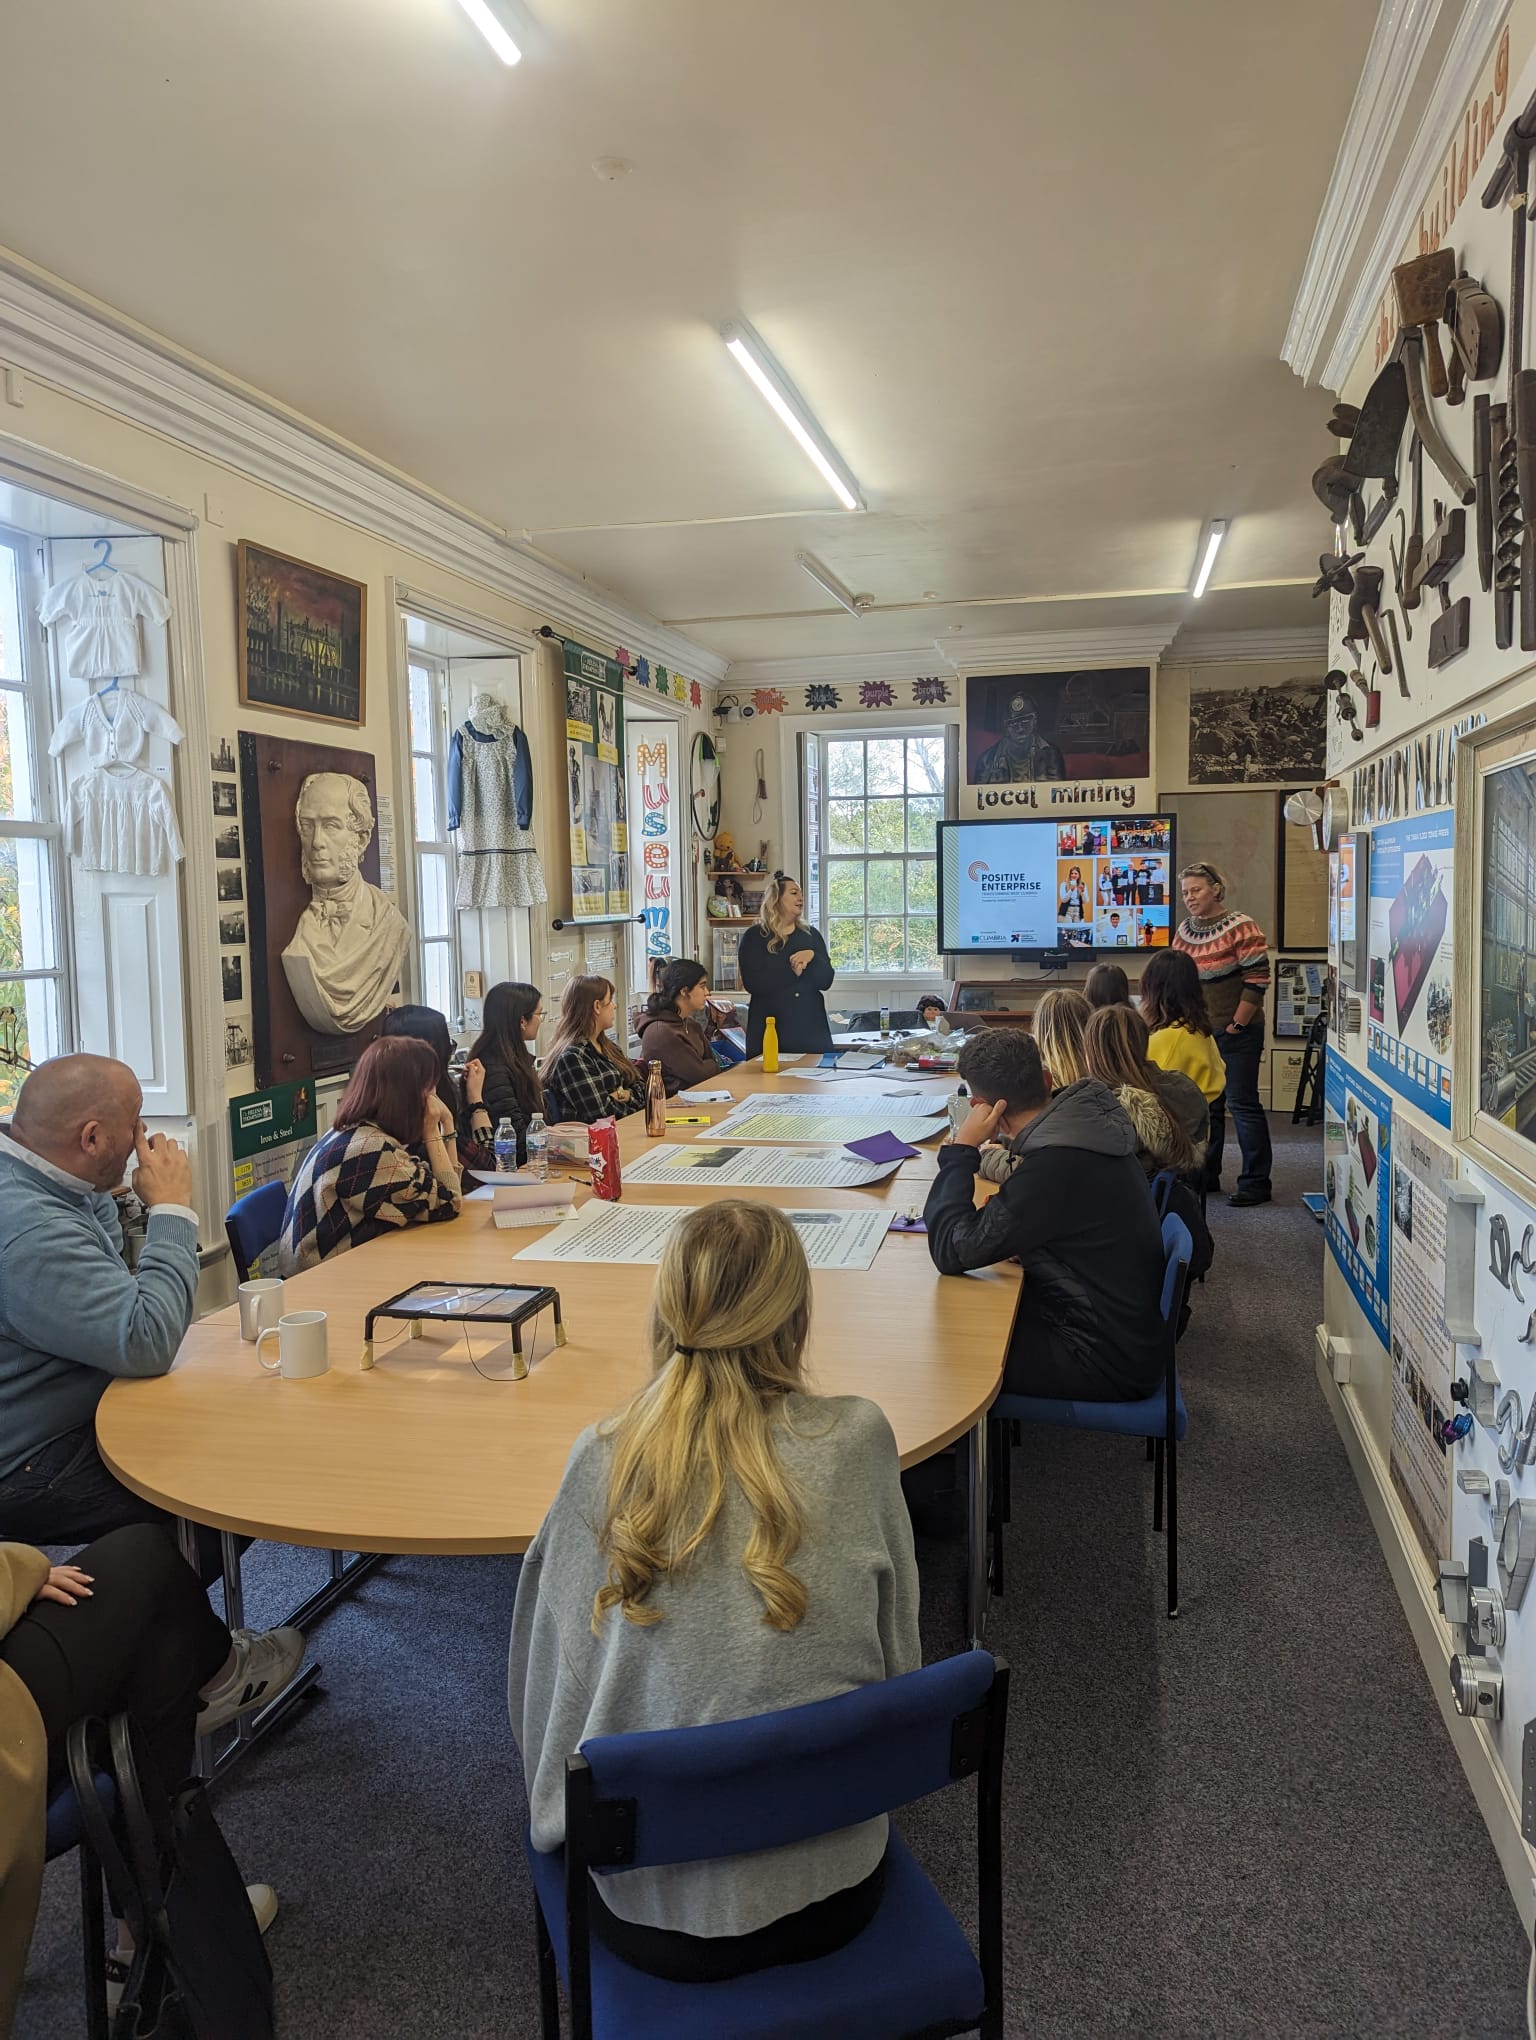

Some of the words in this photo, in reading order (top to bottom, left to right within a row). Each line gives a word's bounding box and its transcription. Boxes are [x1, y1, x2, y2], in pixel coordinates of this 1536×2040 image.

[1419, 24, 1510, 257] building
[865, 688, 889, 701] purple
[977, 785, 1039, 810] local
[1051, 780, 1136, 808] mining
[637, 743, 672, 956] Museums
[981, 873, 1026, 882] POSITIVE
[981, 882, 1041, 891] ENTERPRISE
[260, 1134, 273, 1145] Iron
[273, 1130, 279, 1140] &
[279, 1126, 293, 1137] Steel
